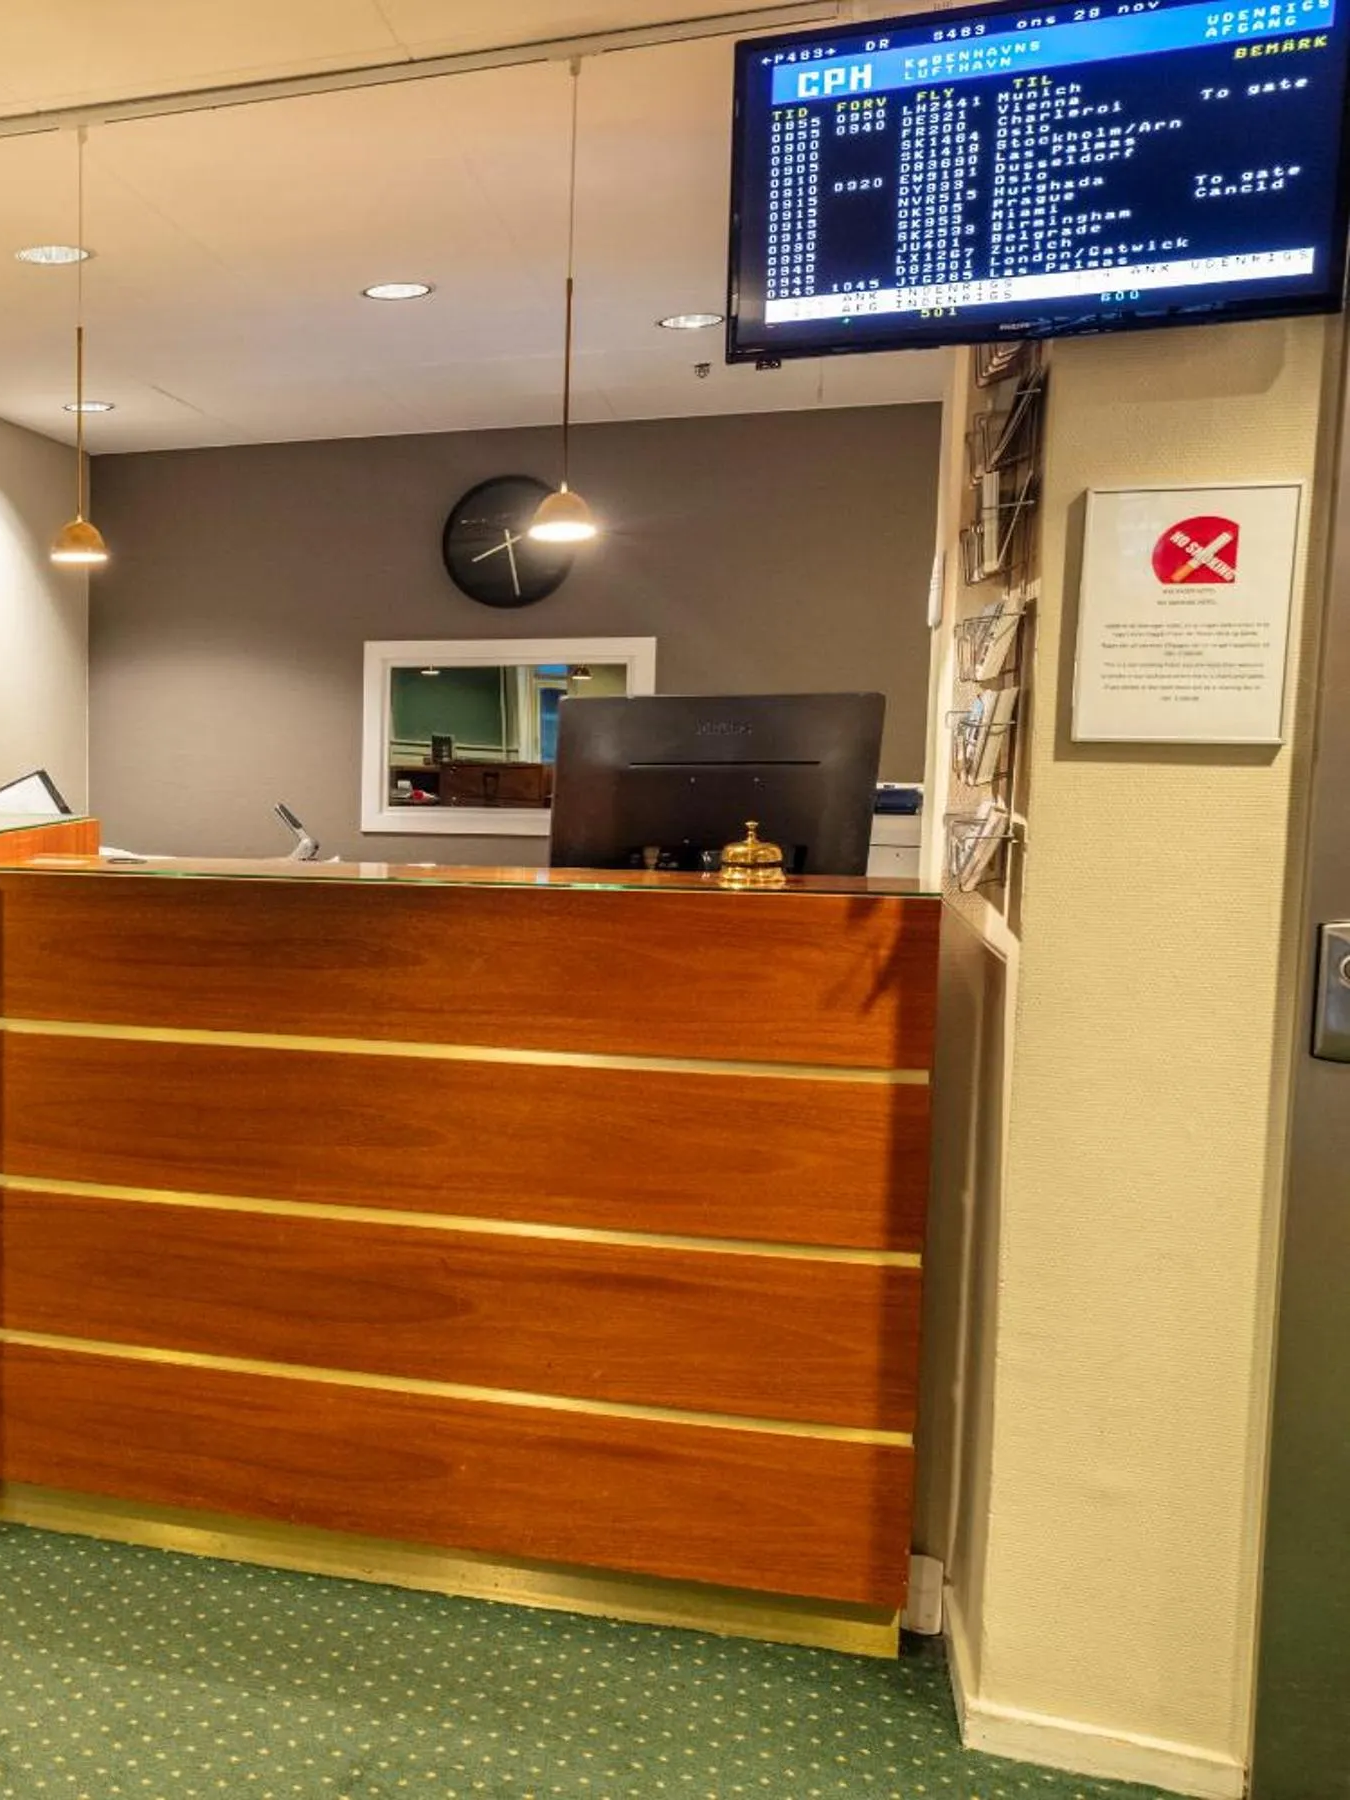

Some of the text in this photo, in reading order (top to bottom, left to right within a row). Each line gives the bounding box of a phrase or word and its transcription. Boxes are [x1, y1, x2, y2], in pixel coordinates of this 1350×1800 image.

[866, 38, 888, 50] DR
[1017, 16, 1054, 28] ons
[1118, 0, 1158, 13] nov
[1206, 15, 1295, 37] AFGANG
[797, 62, 872, 99] CPH
[904, 56, 1010, 80] LUFTHAVN
[773, 107, 807, 121] TID
[837, 96, 886, 112] FORV
[917, 87, 953, 101] FLY
[1013, 74, 1051, 88] TIL
[903, 96, 979, 115] LH2441
[998, 82, 1080, 102] Munich
[998, 101, 1120, 126] Charleroi
[1201, 86, 1228, 100] To
[1248, 76, 1307, 94] gate
[998, 94, 1079, 114] Vienna
[997, 122, 1049, 138] Oslo
[997, 117, 1180, 149] Stockholm/Arn
[995, 147, 1133, 173] Dusseldorf
[996, 148, 1033, 161] Las
[1052, 135, 1134, 154] Palmas
[993, 190, 1073, 209] Prague
[1195, 173, 1222, 185] To
[1241, 164, 1300, 181] gate
[994, 175, 1103, 197] Hurghada
[995, 170, 1046, 184] Oslo
[992, 203, 1057, 219] Miami
[1195, 178, 1283, 197] Cancld
[992, 207, 1130, 232] Birmingham
[898, 237, 959, 252] JU401
[991, 222, 1100, 244] Belgrade
[991, 237, 1071, 254] Zurich
[991, 237, 1186, 266] London/Gatwick
[990, 265, 1026, 277] Las
[1045, 255, 1127, 272] Palmas
[920, 307, 957, 318] 501
[1170, 531, 1191, 548] NO
